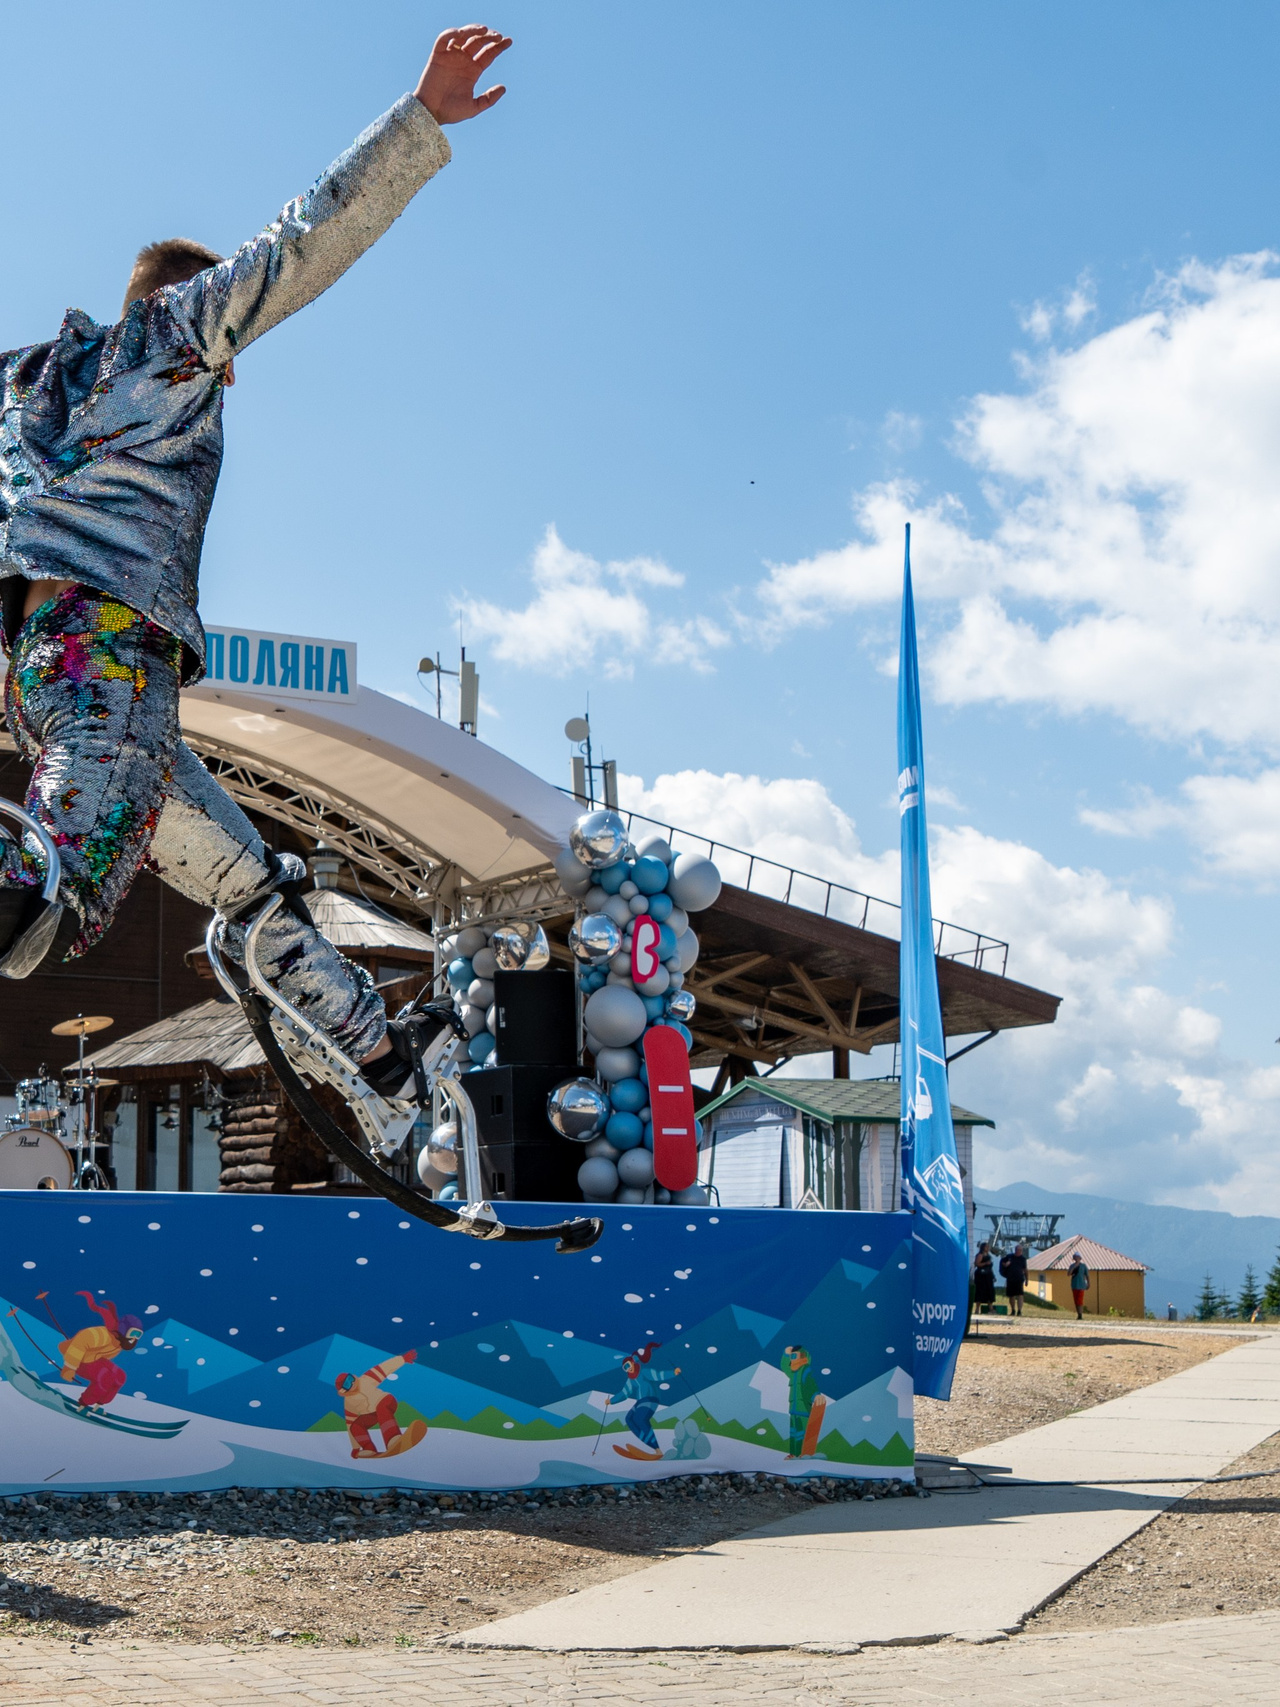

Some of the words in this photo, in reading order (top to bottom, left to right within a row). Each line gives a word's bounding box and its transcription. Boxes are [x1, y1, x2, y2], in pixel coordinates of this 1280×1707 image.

[205, 631, 349, 695] ПОЛЯНА
[15, 1135, 40, 1147] Pearl
[912, 1331, 954, 1358] азпром
